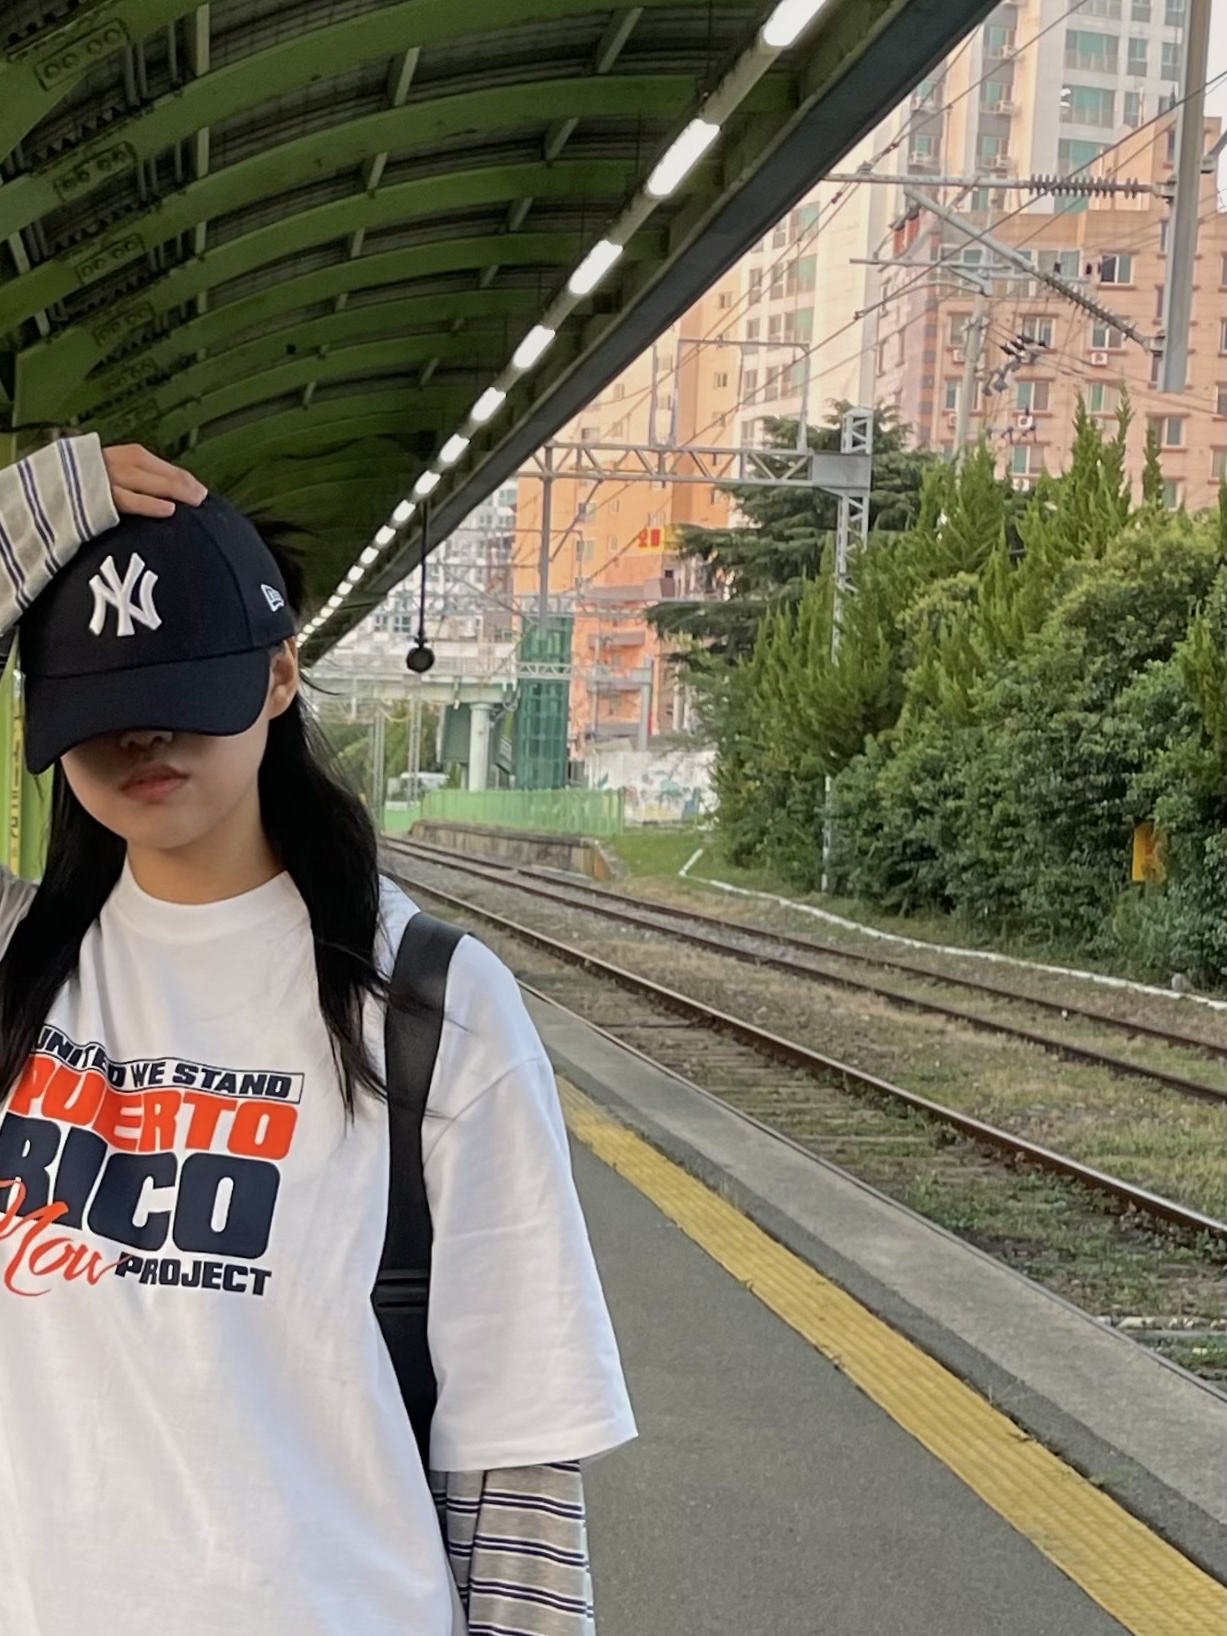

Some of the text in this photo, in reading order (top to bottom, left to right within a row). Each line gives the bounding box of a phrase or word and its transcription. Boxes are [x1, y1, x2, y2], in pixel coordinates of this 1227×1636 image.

[88, 552, 162, 637] NY
[8, 1055, 298, 1160] PUERTO
[130, 1061, 166, 1088] WE
[172, 1063, 293, 1099] STAND
[115, 1251, 273, 1296] PROJECT
